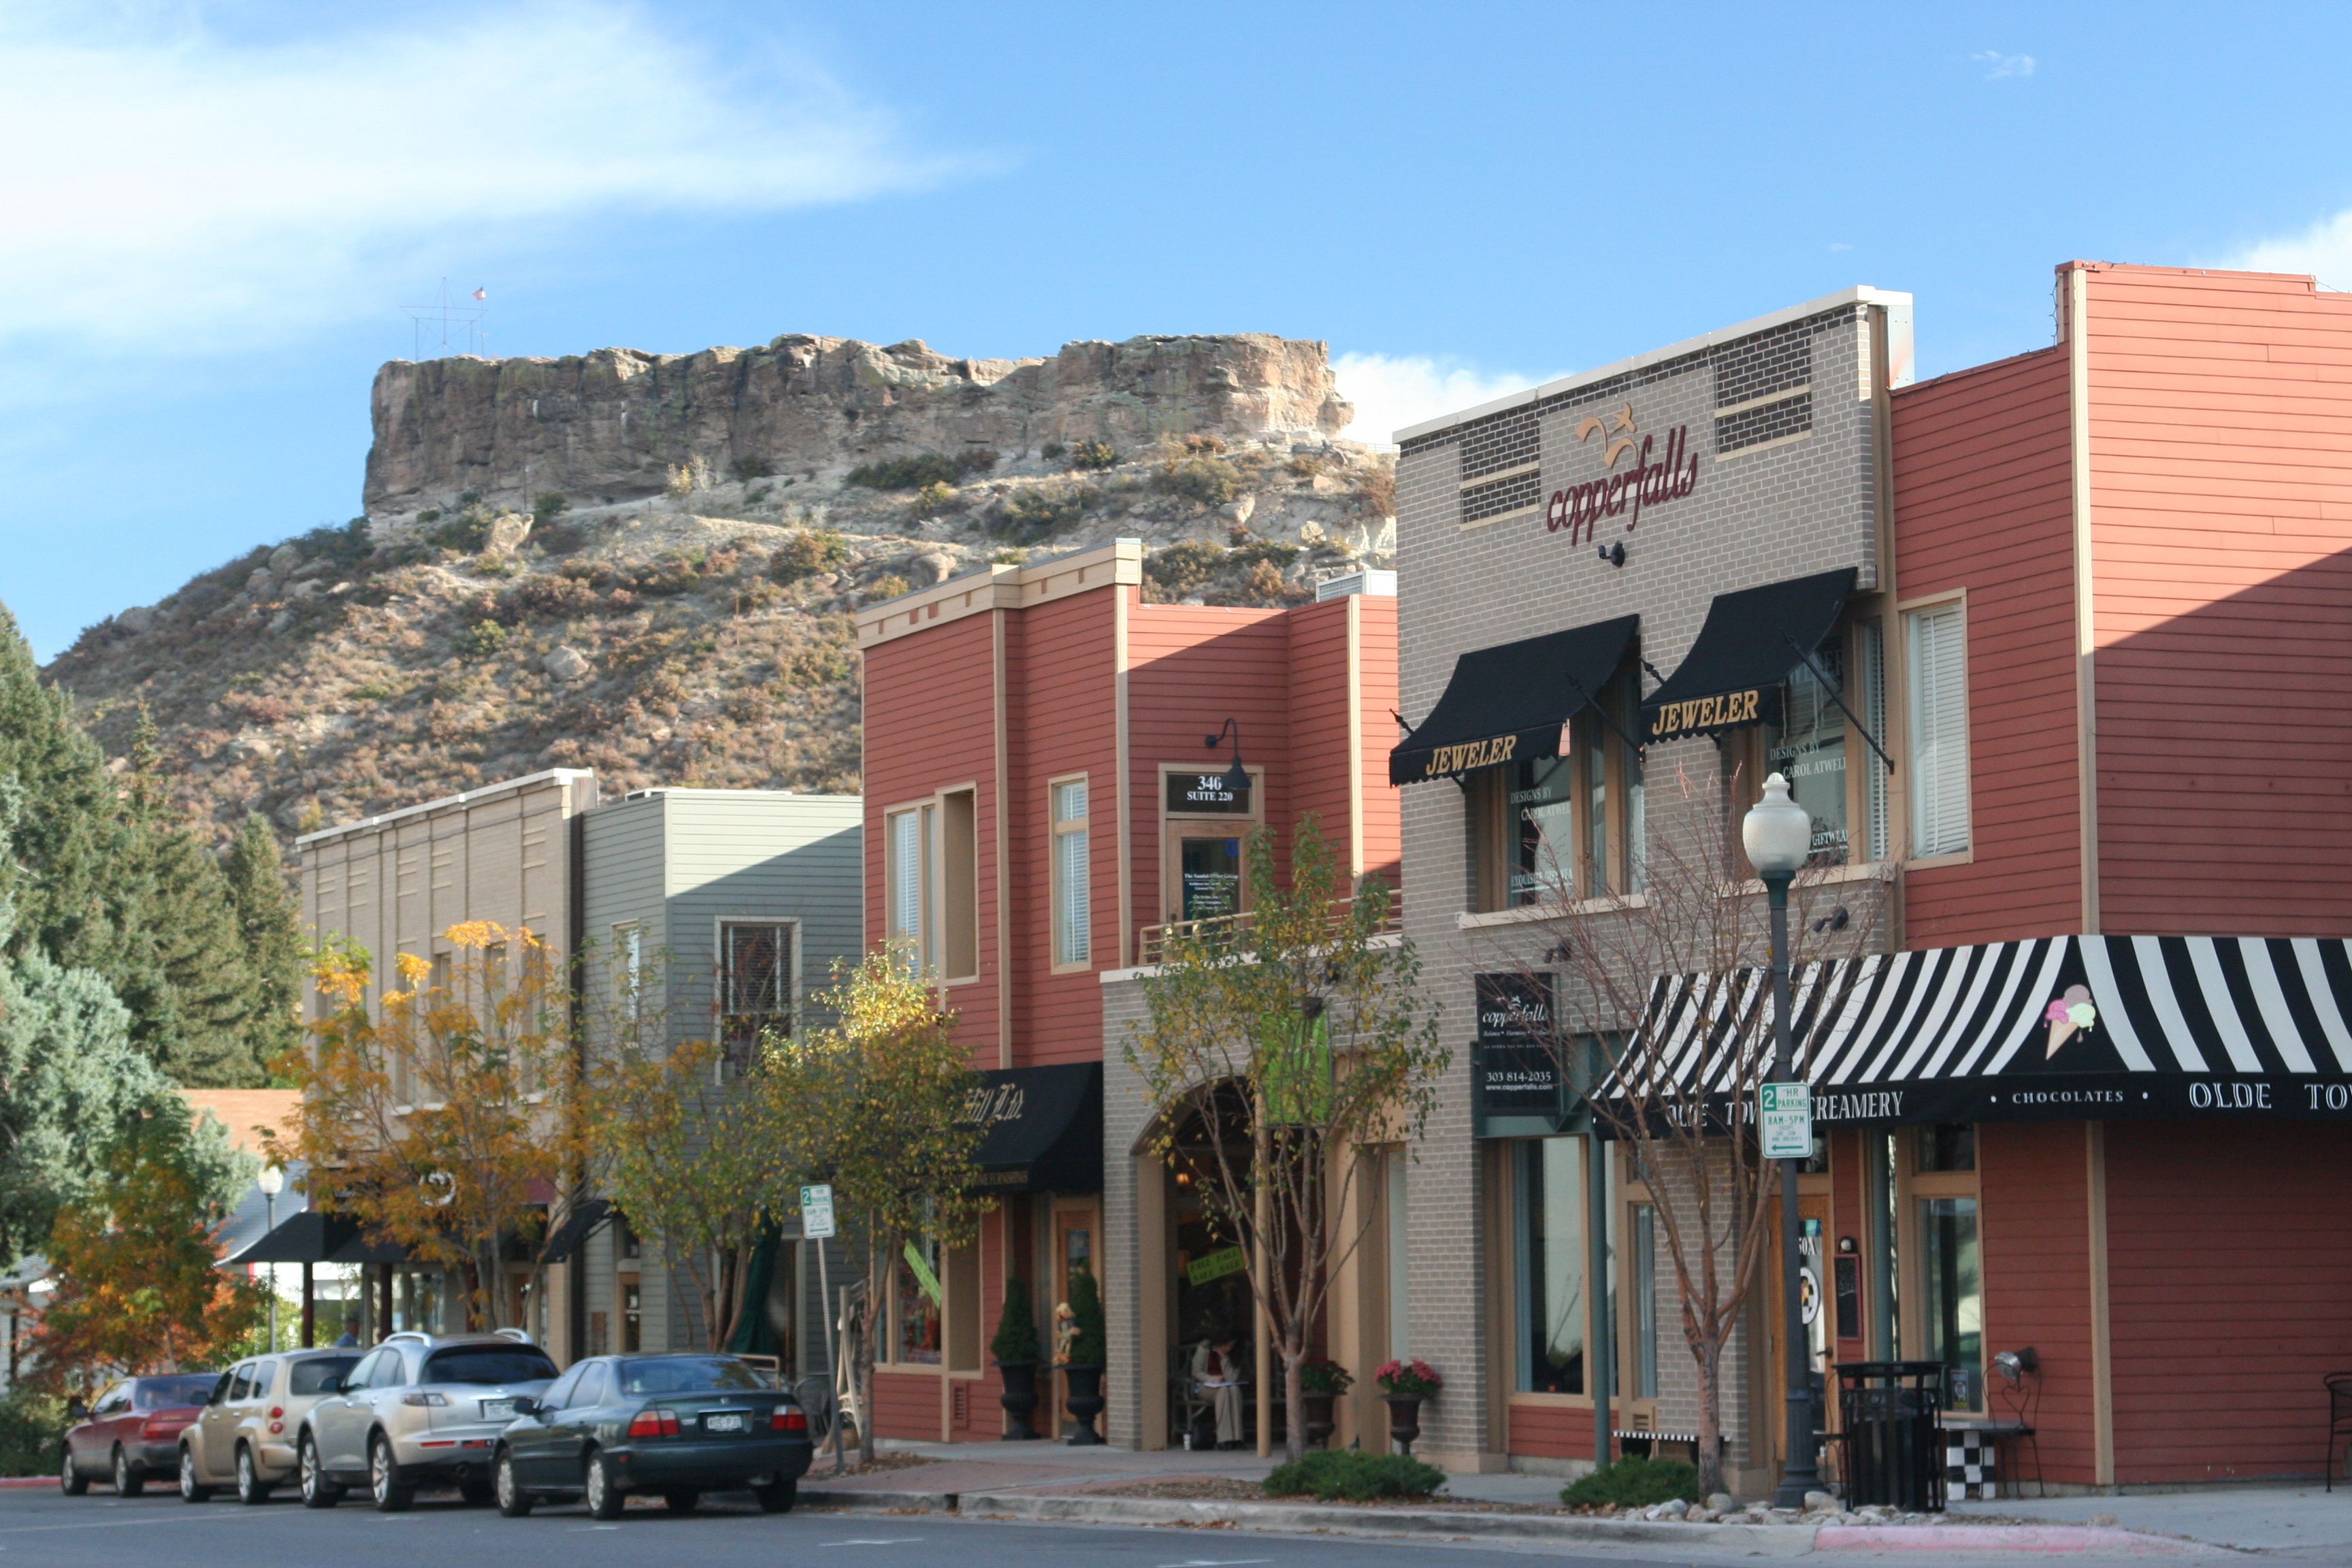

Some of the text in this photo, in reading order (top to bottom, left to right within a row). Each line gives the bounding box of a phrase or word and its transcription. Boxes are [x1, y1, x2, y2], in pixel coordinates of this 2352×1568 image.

[1547, 425, 1698, 547] copperfalls
[1652, 689, 1759, 735] JEWELER
[1426, 735, 1517, 776] JEWELER
[1769, 740, 1820, 761] DESIGNS BY
[1783, 762, 1812, 779] CAROL
[1187, 791, 1234, 801] SUITE 220
[1511, 786, 1552, 804] DESIGNS BY
[1486, 1071, 1551, 1082] 303 814-2035
[1763, 1090, 1774, 1108] 2
[1786, 1088, 1799, 1097] HR
[2012, 1090, 2124, 1104] CHOCOLATES
[2189, 1083, 2352, 1110] OLDE TO
[1778, 1099, 1808, 1109] PARKING
[1726, 1101, 1758, 1126] TOW
[802, 1191, 810, 1205] 2
